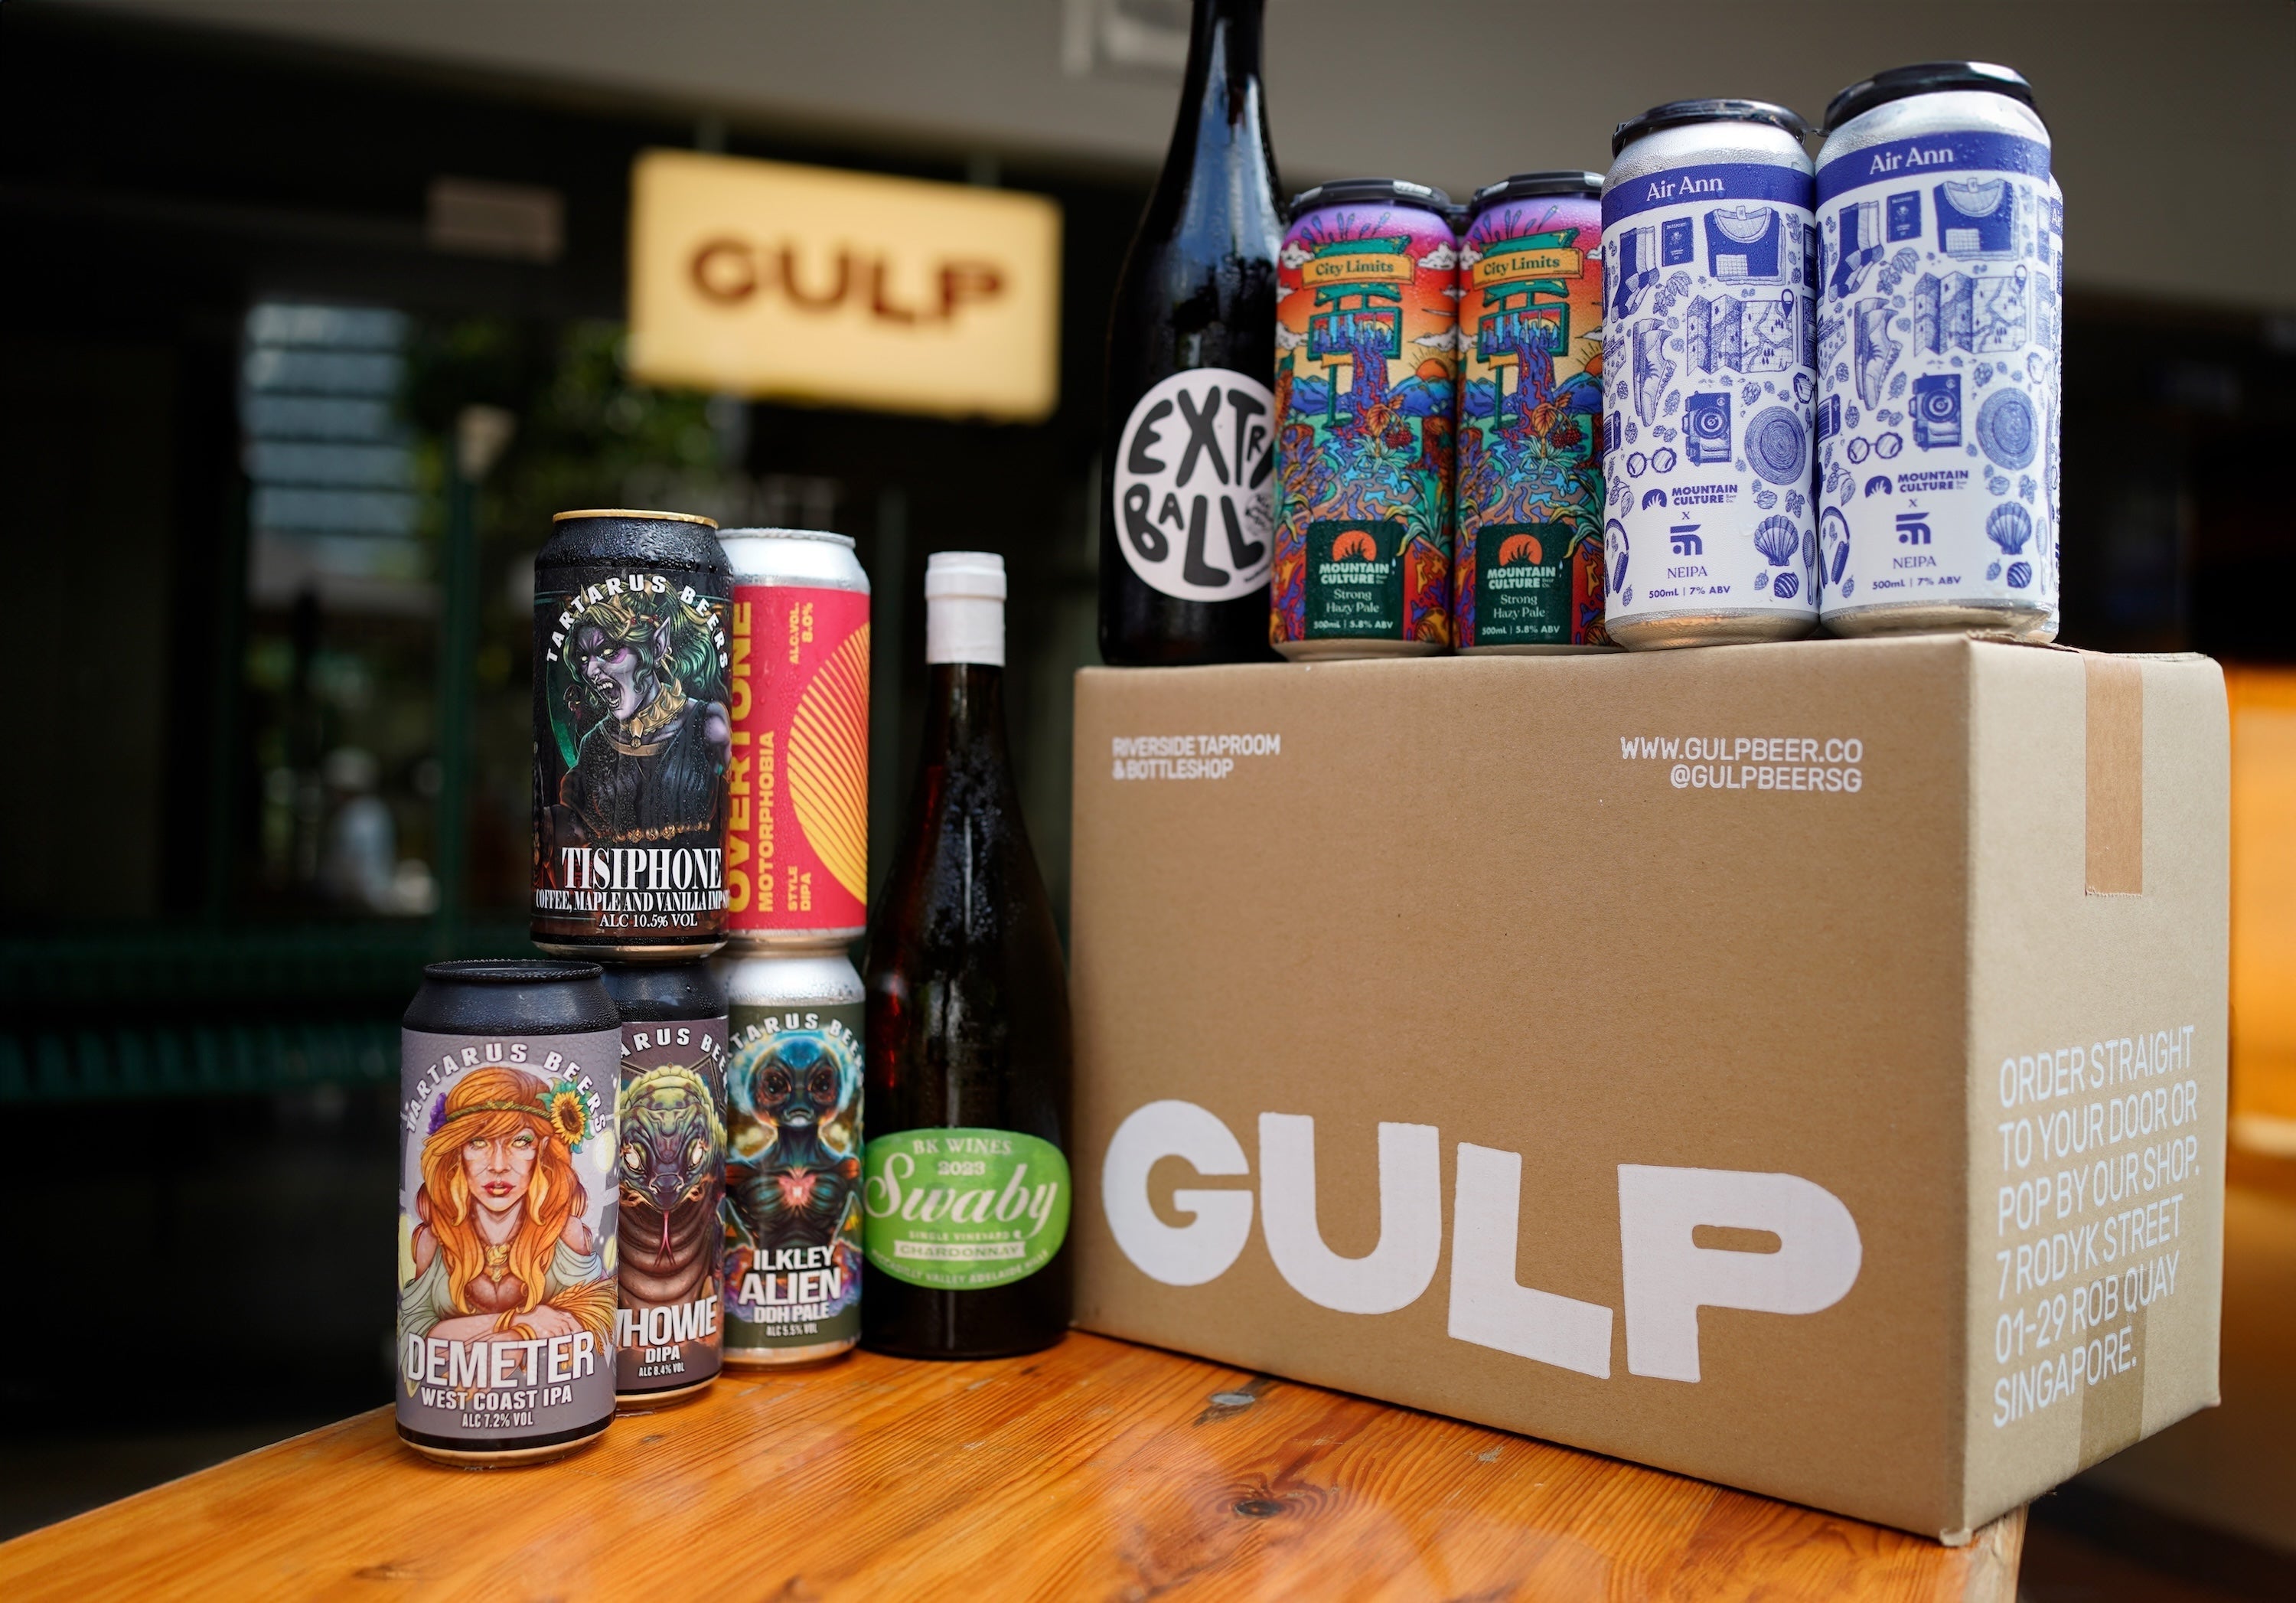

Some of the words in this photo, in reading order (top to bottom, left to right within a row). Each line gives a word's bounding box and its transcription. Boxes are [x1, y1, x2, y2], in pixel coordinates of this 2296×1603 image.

[1869, 152, 1903, 175] Air
[1905, 147, 1954, 168] Ann
[1645, 180, 1676, 202] Air
[1678, 174, 1725, 194] Ann
[1315, 261, 1342, 277] City
[1345, 260, 1394, 274] Limits
[1482, 260, 1510, 277] City
[1512, 256, 1561, 272] Limits
[690, 237, 1004, 326] GULP
[1897, 470, 1969, 484] MOUNTAIN
[1900, 481, 1955, 494] CULTURE
[1671, 484, 1738, 496] MOUNTAIN
[1673, 495, 1724, 506] CULTURE
[1124, 483, 1266, 588] BALL
[1319, 562, 1390, 575] MOUNTAIN
[1487, 566, 1557, 579] MOUNTAIN
[1667, 566, 1708, 579] NEIPA
[1893, 555, 1937, 570] NEIPA
[1320, 573, 1375, 585] CULTURE
[1489, 577, 1541, 590] CULTURE
[1872, 579, 1906, 590] 500mL
[1917, 577, 1935, 586] 7%
[1938, 576, 1962, 586] ABV
[1333, 587, 1373, 602] Strong
[1500, 594, 1538, 606] Strong
[1649, 588, 1679, 599] 500mL
[1689, 586, 1706, 596] 7%
[1709, 586, 1731, 595] ABV
[1326, 601, 1353, 615] Hazy
[1355, 601, 1380, 614] Pale
[1493, 607, 1520, 621] Hazy
[1521, 606, 1547, 618] Pale
[546, 574, 667, 662] TARTARUS
[680, 585, 728, 669] BEERS
[801, 602, 814, 643] 8.0%
[1349, 619, 1373, 628] 5.8%
[1374, 619, 1394, 629] ABV
[1482, 626, 1508, 636] 500mL
[1515, 625, 1539, 634] 5.8%
[1540, 625, 1561, 634] ABV
[1111, 735, 1196, 757] RIVERSIDE
[1196, 733, 1281, 756] TAPROOM
[1619, 736, 1864, 764] WWW.GULPBEER.CO
[1111, 759, 1125, 780] &
[1126, 758, 1235, 780] BOTTLESHOP
[1669, 762, 1864, 793] @GULPBEERSG
[758, 730, 775, 913] MOTORPHOBIA
[561, 847, 722, 890] TISIPHONE
[787, 866, 797, 912] STYLE
[800, 871, 811, 912] DIPA
[536, 888, 573, 913] COFFEE,
[573, 890, 621, 913] MAPLE
[624, 891, 654, 913] AND
[655, 890, 707, 912] VANILLA
[599, 914, 629, 928] ALC
[633, 914, 669, 929] 10.5%
[671, 913, 698, 927] VOL
[727, 1012, 820, 1059] TARUS
[1999, 1046, 2086, 1109] ORDER
[2090, 1024, 2195, 1089] STRAIGHT
[406, 1042, 528, 1134] TARTARUS
[543, 1050, 607, 1133] BEERS
[1998, 1118, 2033, 1173] TO
[2037, 1102, 2105, 1163] YOUR
[2108, 1089, 2168, 1144] DOOR
[2171, 1079, 2199, 1128] OR
[912, 1138, 940, 1155] BK
[945, 1137, 1013, 1155] WINES
[938, 1160, 987, 1177] 2023
[863, 1151, 1059, 1240] Swaby
[1998, 1176, 2052, 1238] POP
[2056, 1163, 2090, 1220] BY
[2092, 1151, 2140, 1208] OUR
[2142, 1134, 2200, 1194] SHOP.
[899, 1243, 1020, 1258] CHARDONNAY
[1101, 1098, 1864, 1384] GULP
[1995, 1249, 2014, 1301] 7
[2016, 1220, 2100, 1294] RODYK
[2102, 1193, 2184, 1263] STREET
[752, 1244, 836, 1272] ILKLEY
[737, 1267, 841, 1306] ALIEN
[753, 1305, 790, 1324] DDH
[791, 1301, 830, 1323] PALE
[1994, 1294, 2067, 1366] 01-29
[2071, 1274, 2119, 1335] ROB
[2122, 1249, 2180, 1314] QUAY
[766, 1325, 782, 1337] ALC
[782, 1324, 803, 1336] 5.5%
[804, 1322, 818, 1334] VOL
[408, 1330, 595, 1389] DEMETER
[644, 1345, 681, 1364] DIPA
[638, 1366, 653, 1377] ALC
[653, 1364, 672, 1376] 8.4%
[672, 1362, 685, 1373] VOL
[1991, 1325, 2138, 1429] SINGAPORE.
[420, 1386, 468, 1411] WEST
[472, 1389, 538, 1412] COAST
[542, 1384, 573, 1408] IPA
[461, 1413, 481, 1428] ALC
[484, 1412, 510, 1428] 7.2%
[514, 1411, 534, 1427] VOL
